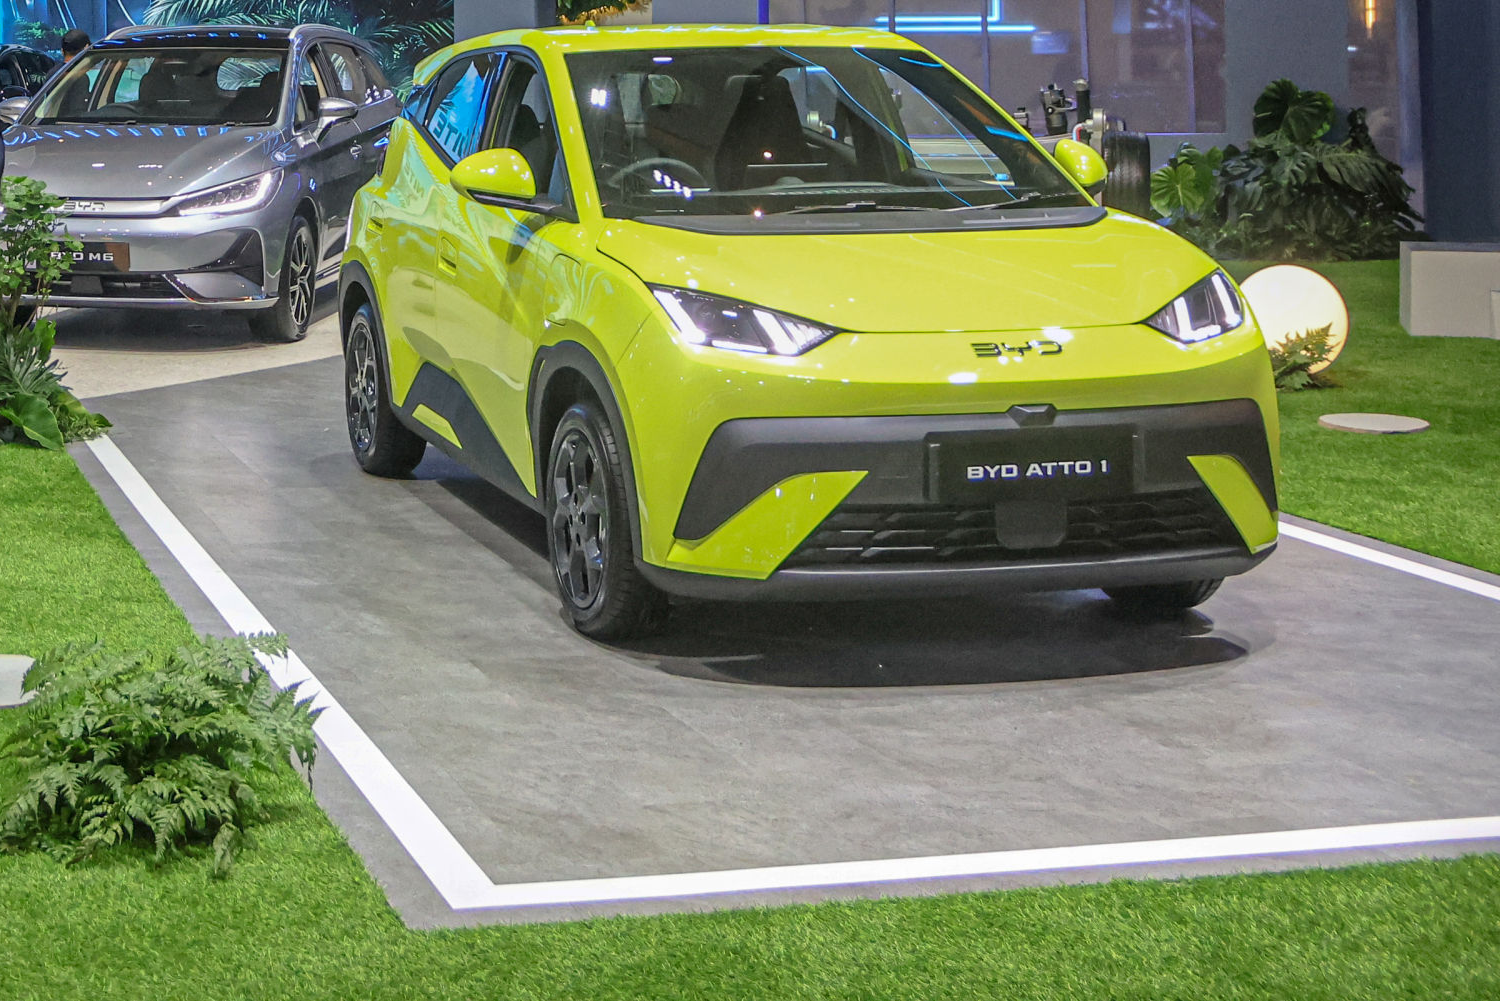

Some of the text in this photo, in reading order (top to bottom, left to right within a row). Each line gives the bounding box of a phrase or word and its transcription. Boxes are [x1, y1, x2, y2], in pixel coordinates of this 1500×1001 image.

[51, 251, 114, 261] BD M6
[970, 340, 1063, 357] BYD
[967, 459, 1108, 479] BYD ATTO 1
